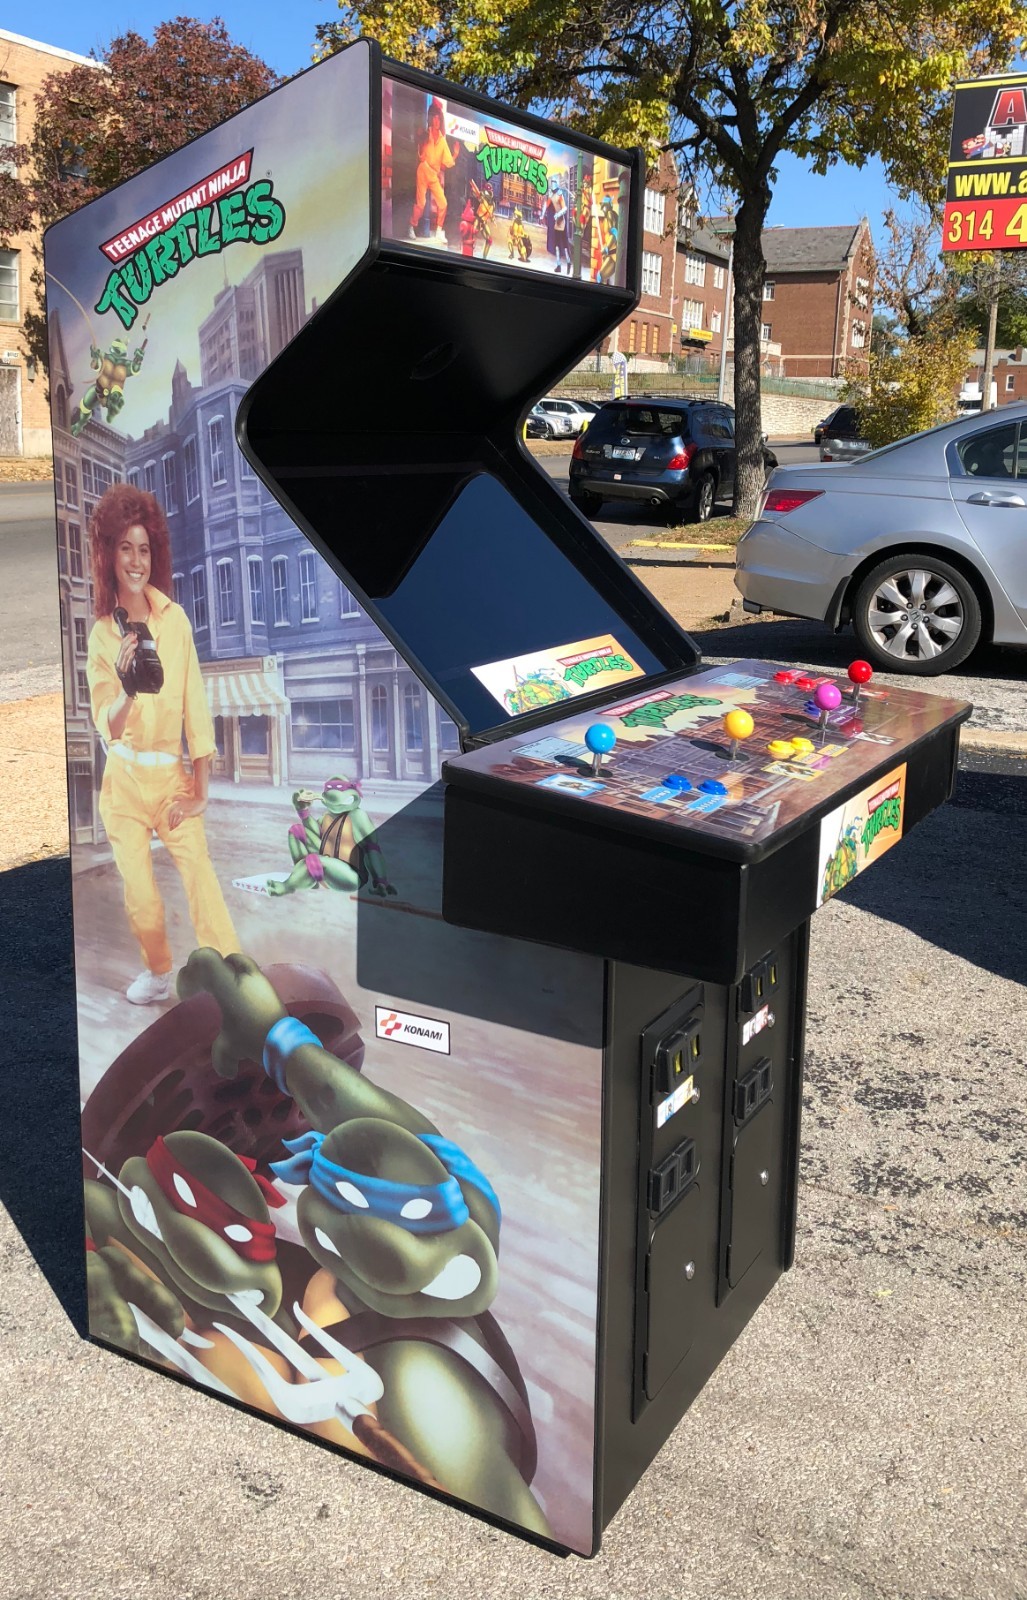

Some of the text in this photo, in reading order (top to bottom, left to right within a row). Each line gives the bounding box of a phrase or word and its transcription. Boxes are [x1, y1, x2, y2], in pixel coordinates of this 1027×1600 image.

[475, 143, 549, 196] TURTLES
[105, 160, 247, 258] TEENAGE MUTANT NINJA
[948, 202, 1027, 244] 314 4
[94, 178, 286, 331] TURTLES
[562, 654, 634, 688] TURTLES
[619, 693, 723, 729] TURTLES
[861, 796, 901, 858] TURTLES
[403, 1024, 443, 1040] KONAMI
